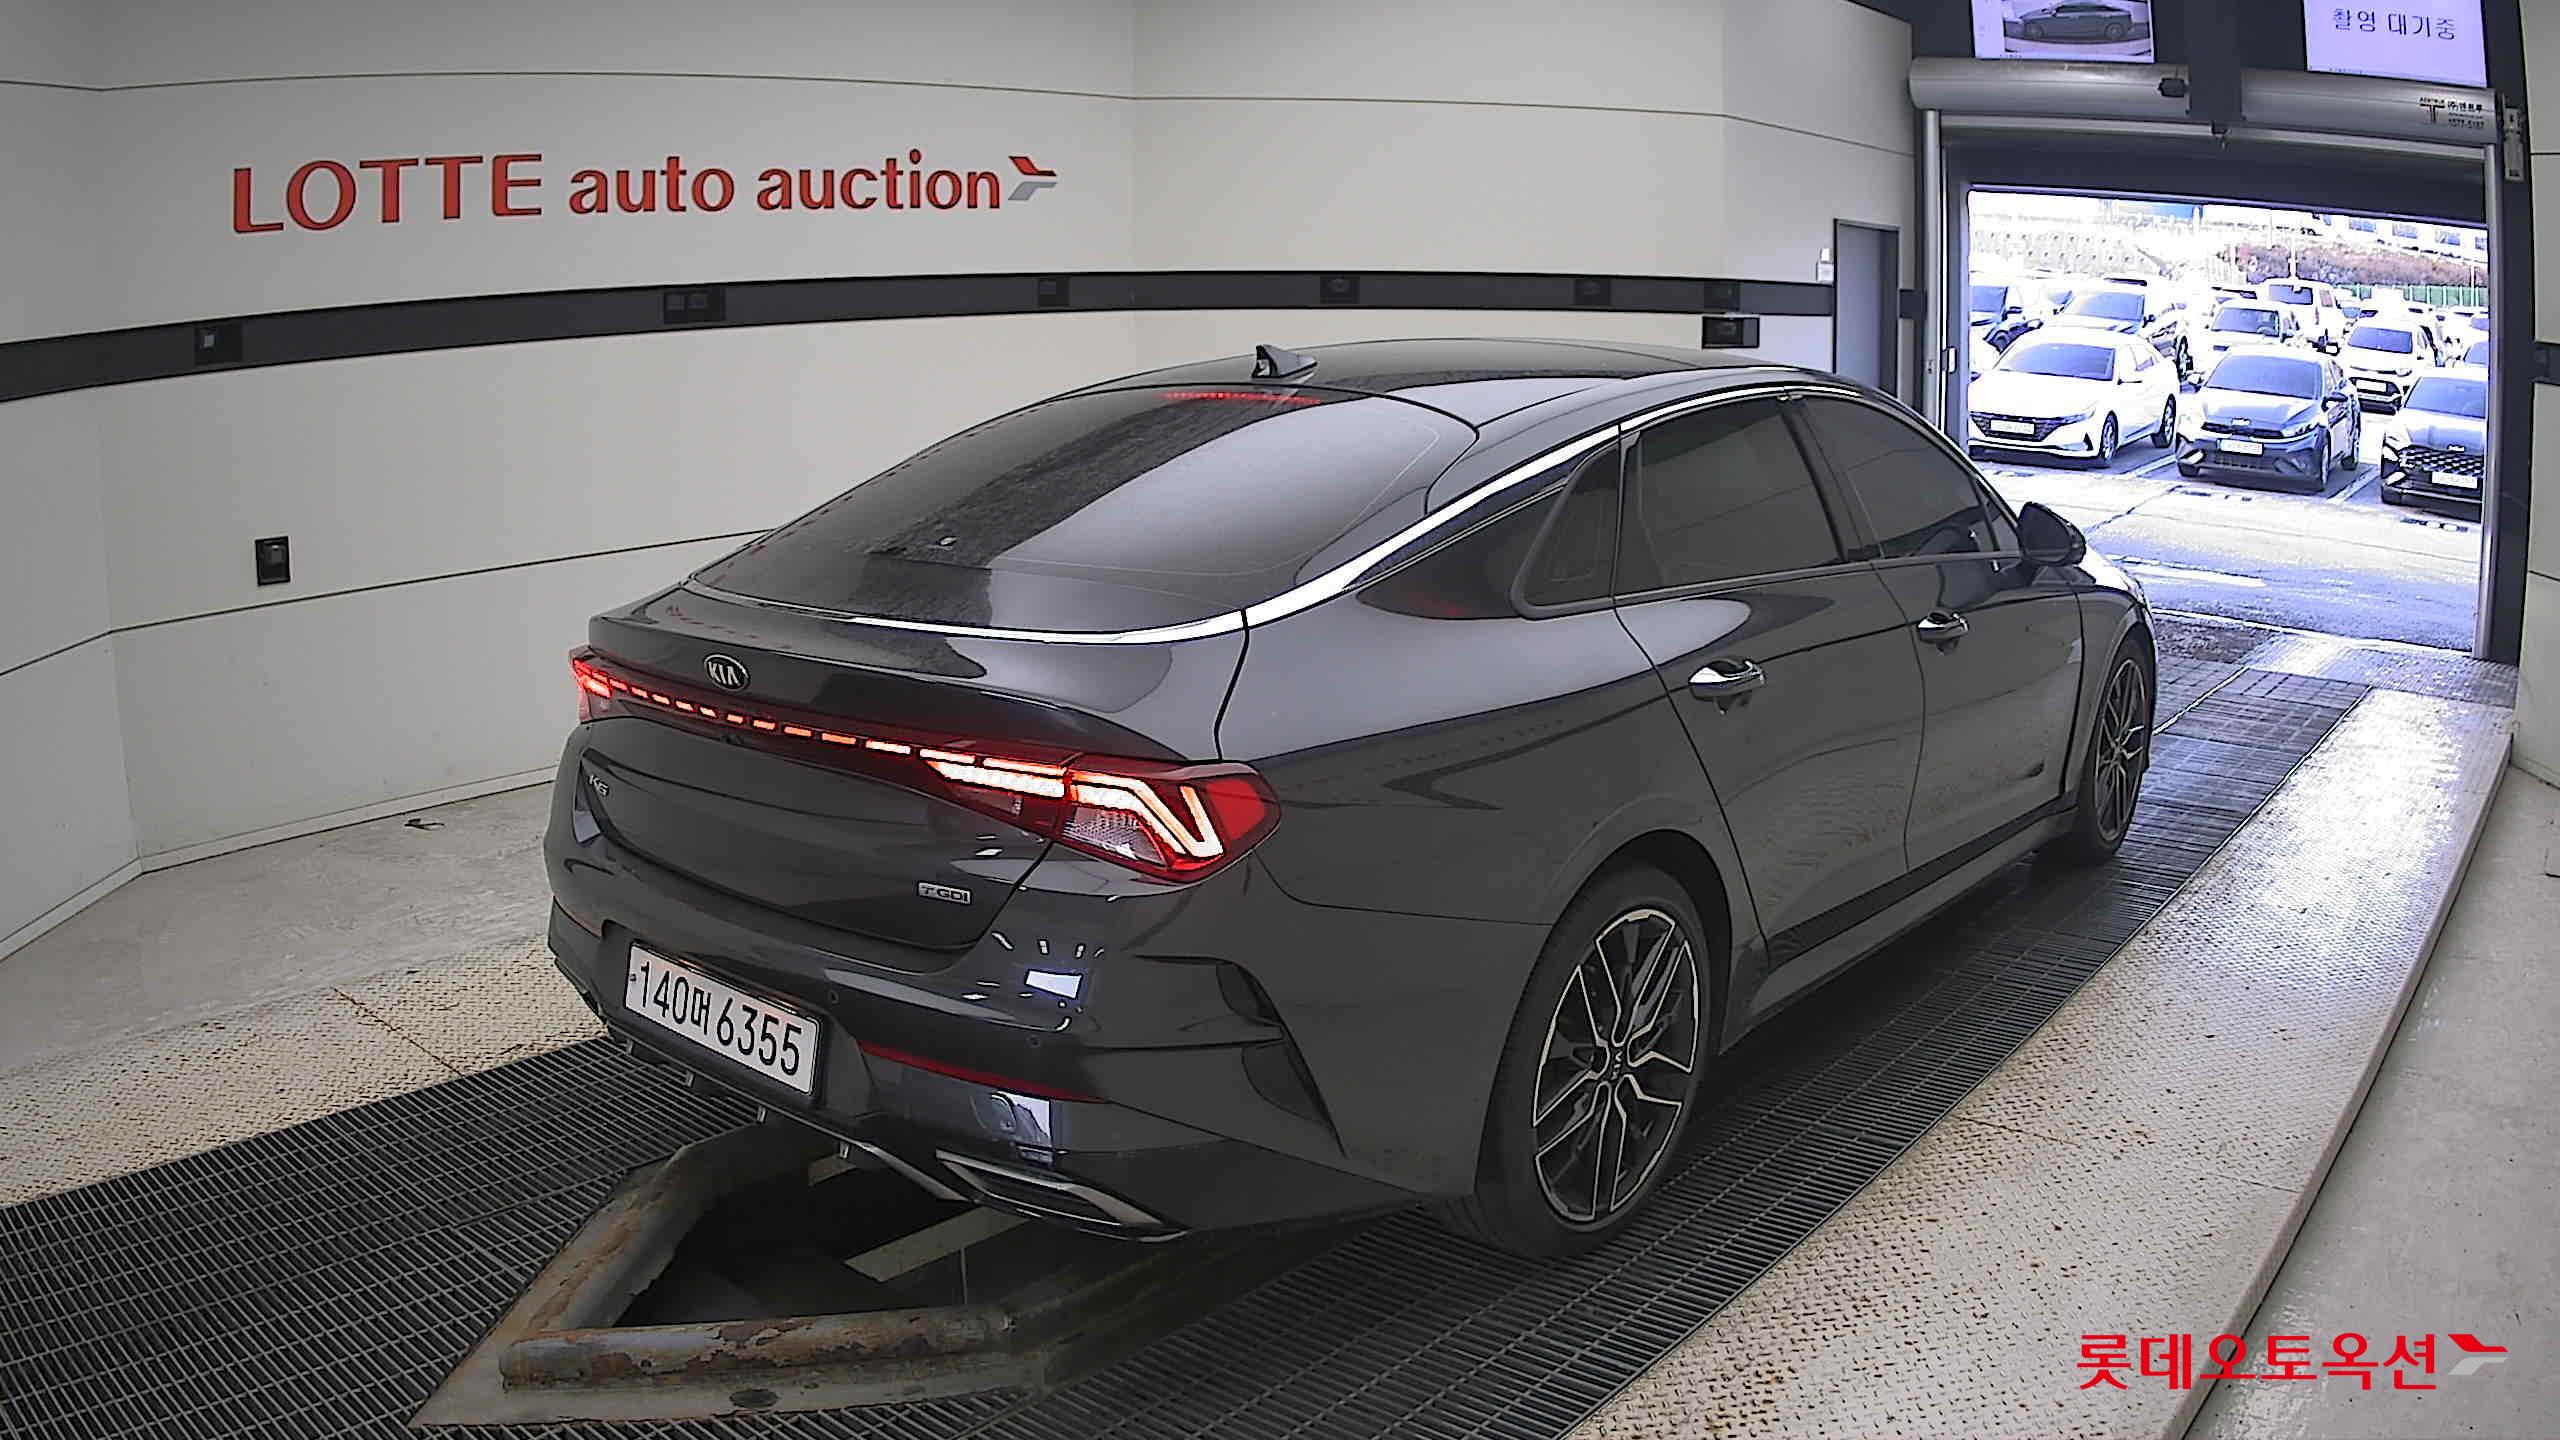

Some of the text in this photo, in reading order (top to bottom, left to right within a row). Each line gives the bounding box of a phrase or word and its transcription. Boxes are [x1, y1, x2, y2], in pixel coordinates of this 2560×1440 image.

[2387, 13, 2456, 41] 대기중
[233, 149, 1001, 234] LOTTE auto auction
[708, 661, 741, 686] KIA
[717, 997, 802, 1076] 6355
